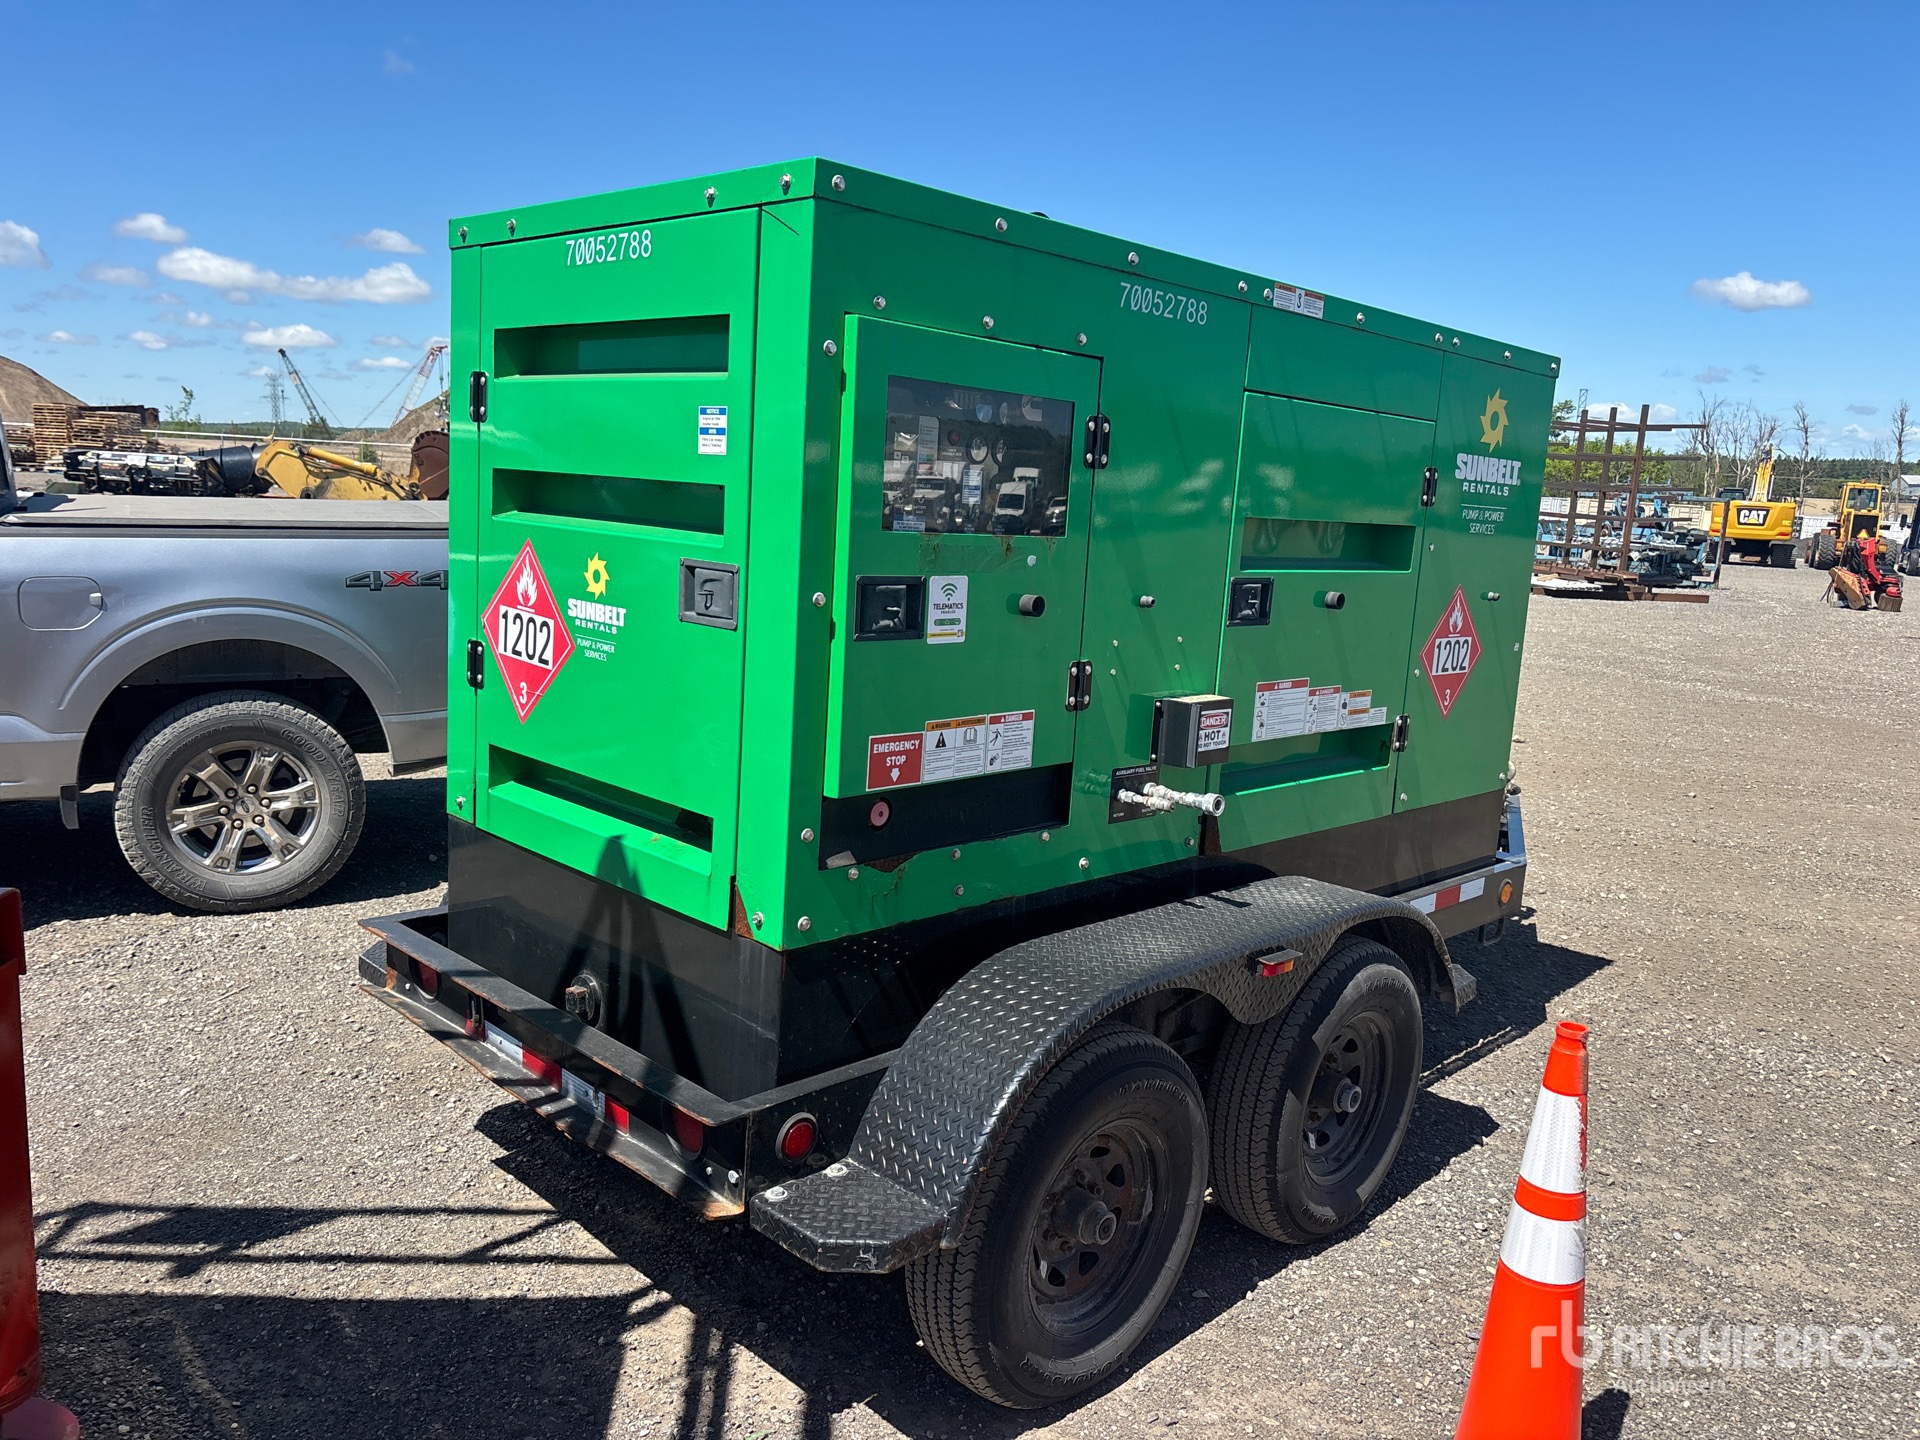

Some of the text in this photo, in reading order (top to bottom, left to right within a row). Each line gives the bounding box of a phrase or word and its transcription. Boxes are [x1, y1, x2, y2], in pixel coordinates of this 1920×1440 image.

[566, 230, 652, 266] 70052788
[1120, 282, 1208, 326] 70052788
[1455, 452, 1522, 486] SUNBELT
[1462, 482, 1509, 496] RENTALS
[1462, 509, 1505, 522] PUMP & POWER
[1739, 510, 1767, 524] CAT
[1469, 523, 1496, 535] SERVICES
[567, 598, 627, 628] SUNBELT
[574, 619, 618, 635] RENTALS
[501, 608, 552, 667] 1202
[576, 637, 615, 654] PUMP & POWER
[584, 649, 607, 662] SERVICES
[1436, 638, 1470, 674] 1202
[518, 682, 528, 705] 3
[1444, 689, 1451, 706] 3
[1006, 714, 1023, 723] DANGER
[1202, 716, 1227, 727] DANGER
[1204, 730, 1221, 742] HOT
[873, 740, 920, 754] EMERGENCY
[886, 755, 907, 767] STOP
[141, 806, 207, 892] WRANGLER
